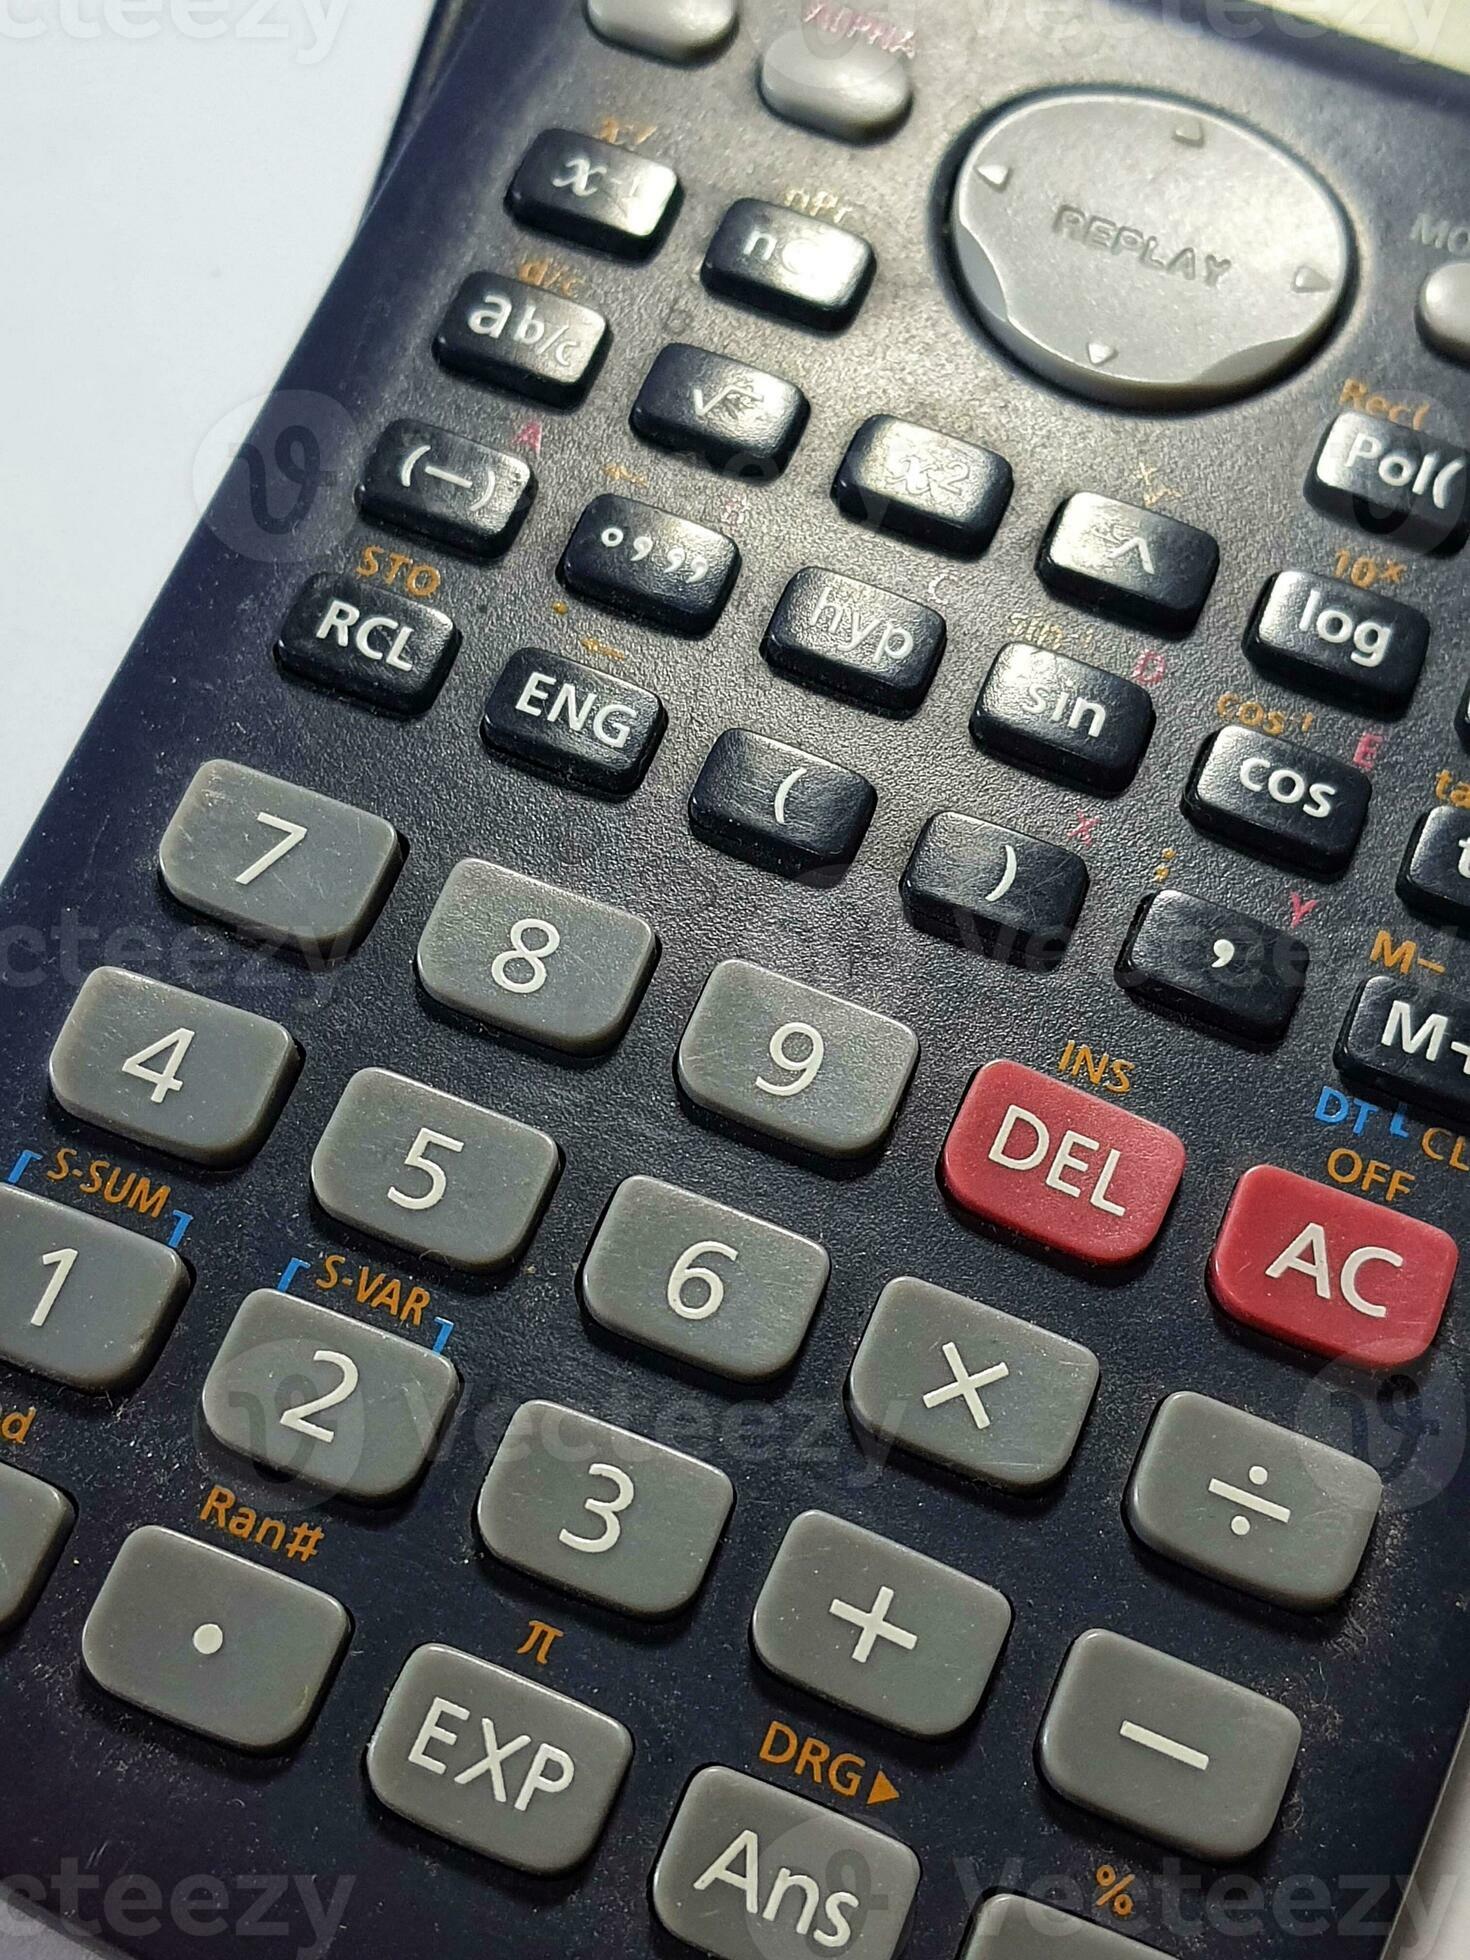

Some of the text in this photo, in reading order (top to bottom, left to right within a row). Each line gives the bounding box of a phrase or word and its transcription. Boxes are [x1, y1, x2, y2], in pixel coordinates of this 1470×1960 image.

[1050, 205, 1231, 287] REPLAY
[1346, 432, 1466, 510] Pol(
[355, 545, 441, 597] STO
[316, 600, 414, 672] RCL
[808, 588, 915, 664] hyp
[1299, 589, 1393, 669] log
[515, 672, 638, 749] ENG
[1023, 682, 1107, 738] sin
[1239, 756, 1337, 818] cos
[1352, 732, 1384, 771] E
[234, 811, 308, 886] 7
[1290, 891, 1317, 928] Y
[490, 917, 561, 994] 8
[121, 1027, 196, 1104] 4
[755, 1021, 825, 1098] 9
[1058, 1039, 1136, 1095] INS
[46, 1148, 172, 1218] S-SUM
[387, 1126, 465, 1211] 5
[987, 1104, 1126, 1217] DEL
[1327, 1147, 1417, 1202] OFF
[30, 1247, 79, 1328] 1
[315, 1255, 431, 1328] S-VAR
[666, 1240, 740, 1321] 6
[1264, 1222, 1404, 1319] AC
[279, 1350, 360, 1444] 2
[199, 1484, 325, 1562] Ran#
[558, 1463, 635, 1554] 3
[407, 1696, 576, 1813] EXP
[758, 1720, 868, 1796] DRG
[692, 1829, 860, 1949] Ans
[1095, 1863, 1136, 1917] %
